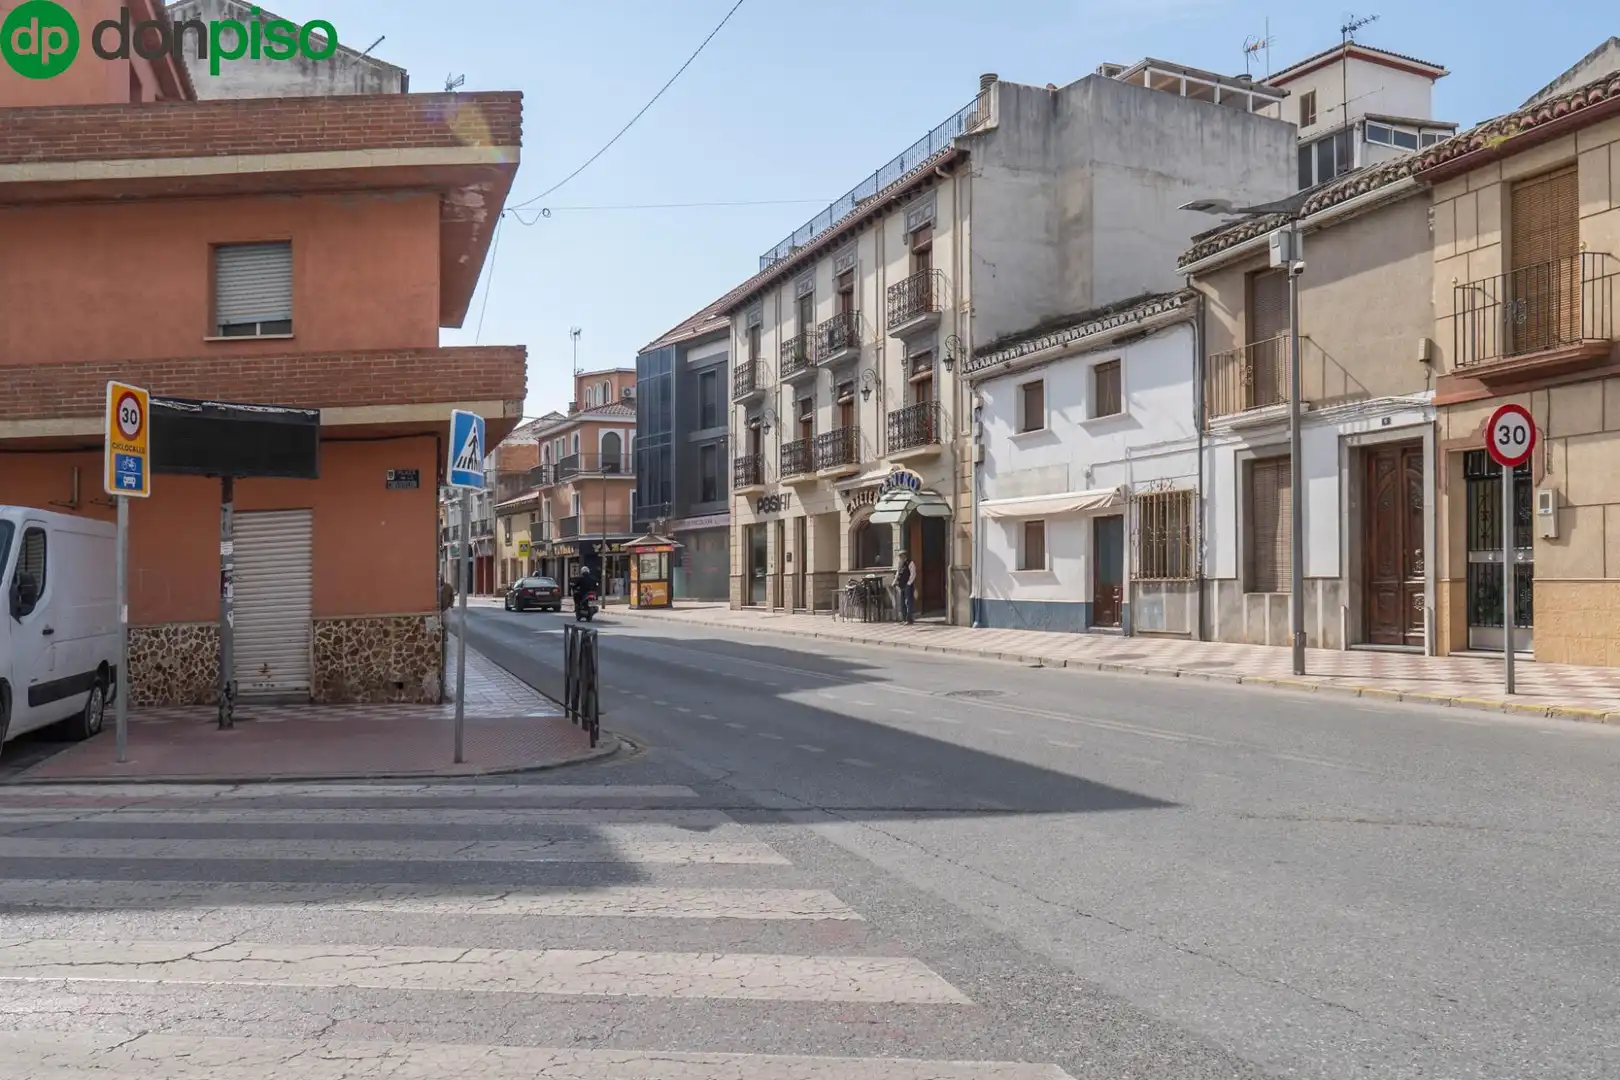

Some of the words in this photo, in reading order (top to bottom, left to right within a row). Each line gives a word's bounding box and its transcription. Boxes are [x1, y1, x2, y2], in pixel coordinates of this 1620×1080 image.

[122, 407, 138, 425] 30
[1498, 424, 1526, 446] 30
[878, 471, 921, 497] CENTRO
[846, 489, 881, 515] CAFETER
